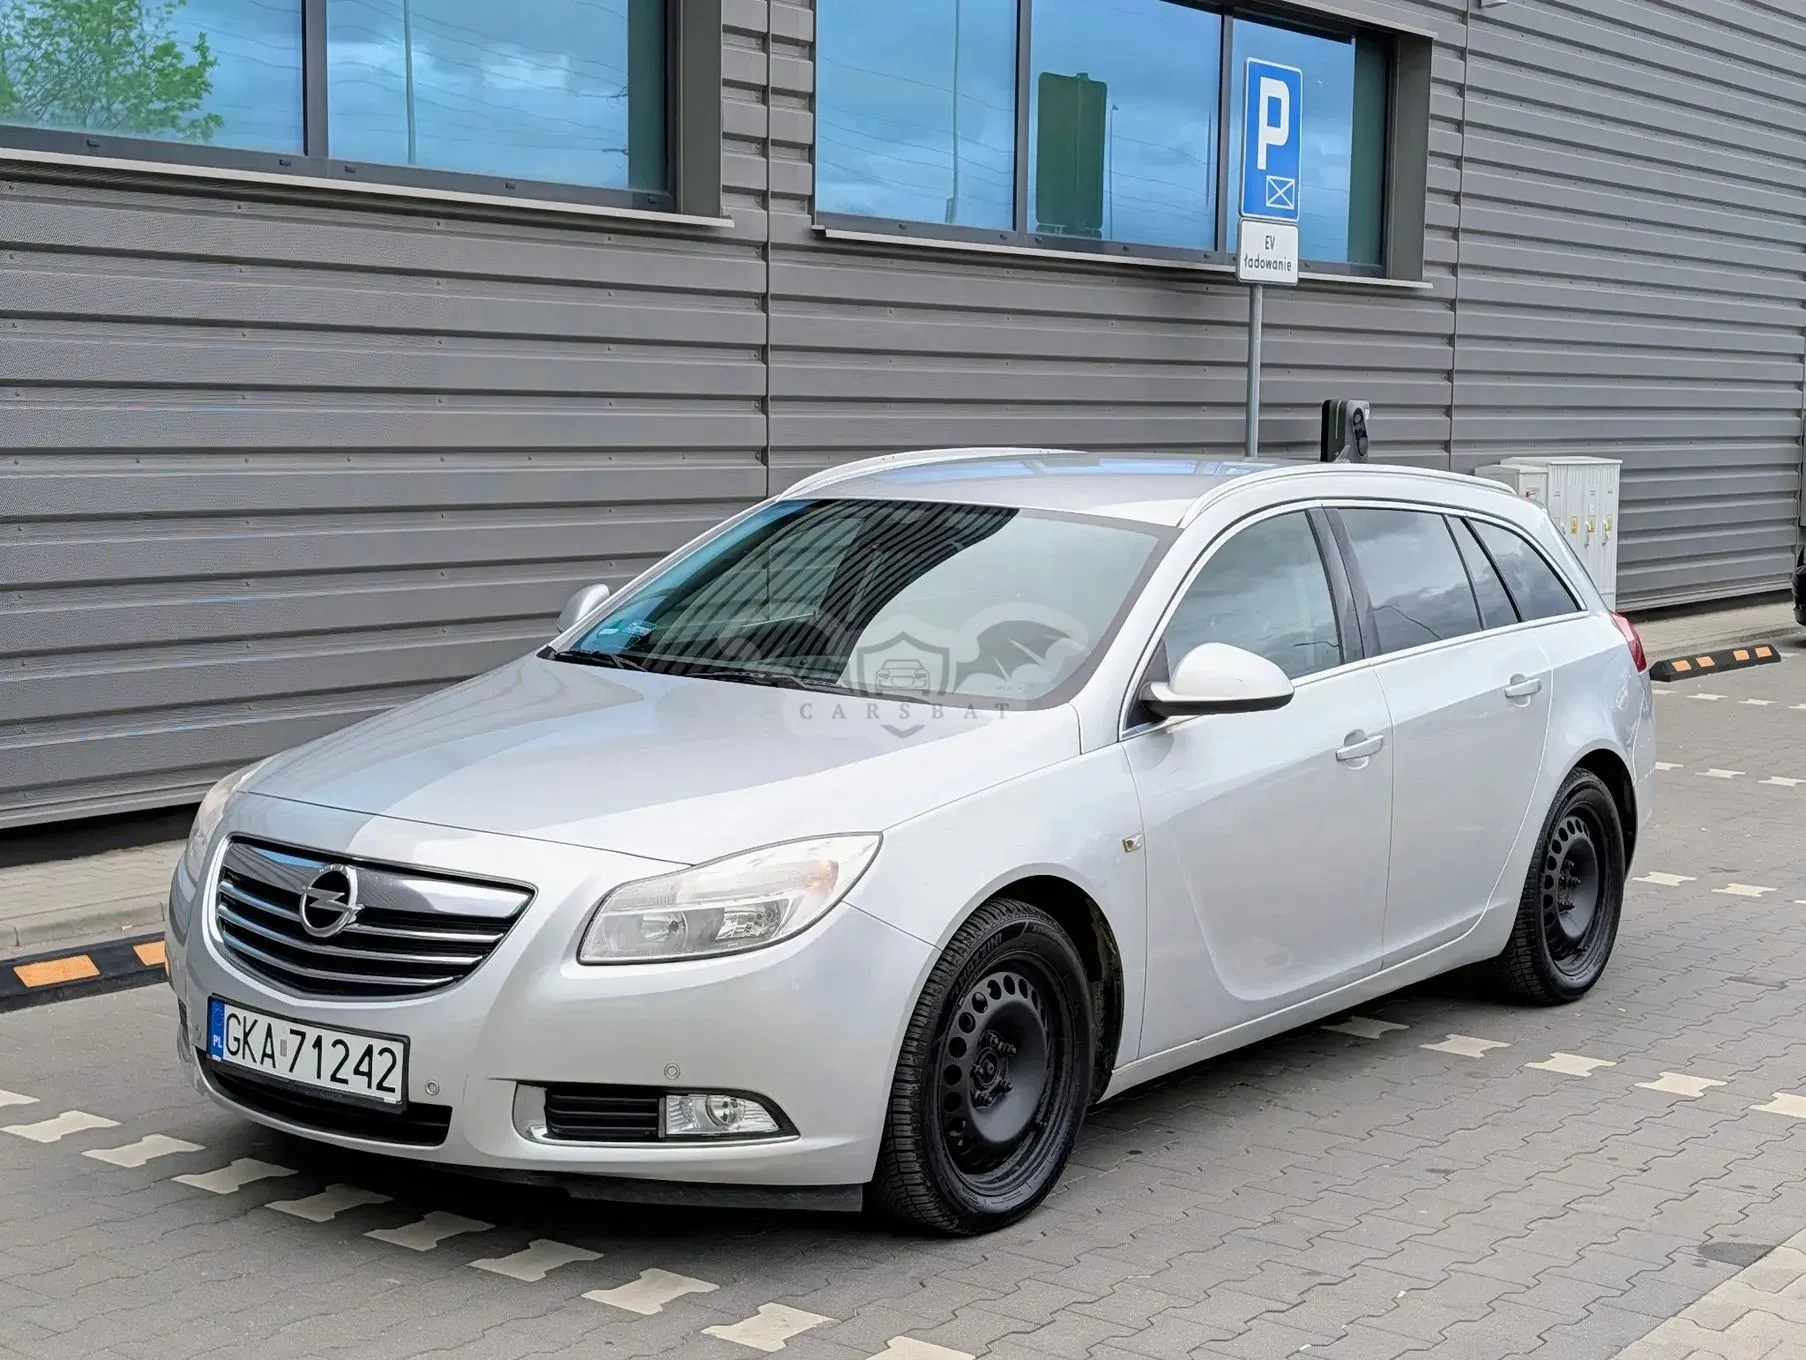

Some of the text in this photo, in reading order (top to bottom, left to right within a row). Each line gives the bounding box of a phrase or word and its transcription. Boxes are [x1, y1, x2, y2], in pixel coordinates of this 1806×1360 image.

[1257, 76, 1290, 170] P
[1264, 234, 1276, 250] EV
[1243, 253, 1292, 271] ładowanie
[212, 1034, 223, 1048] PL
[225, 1012, 398, 1093] GKA 71242
